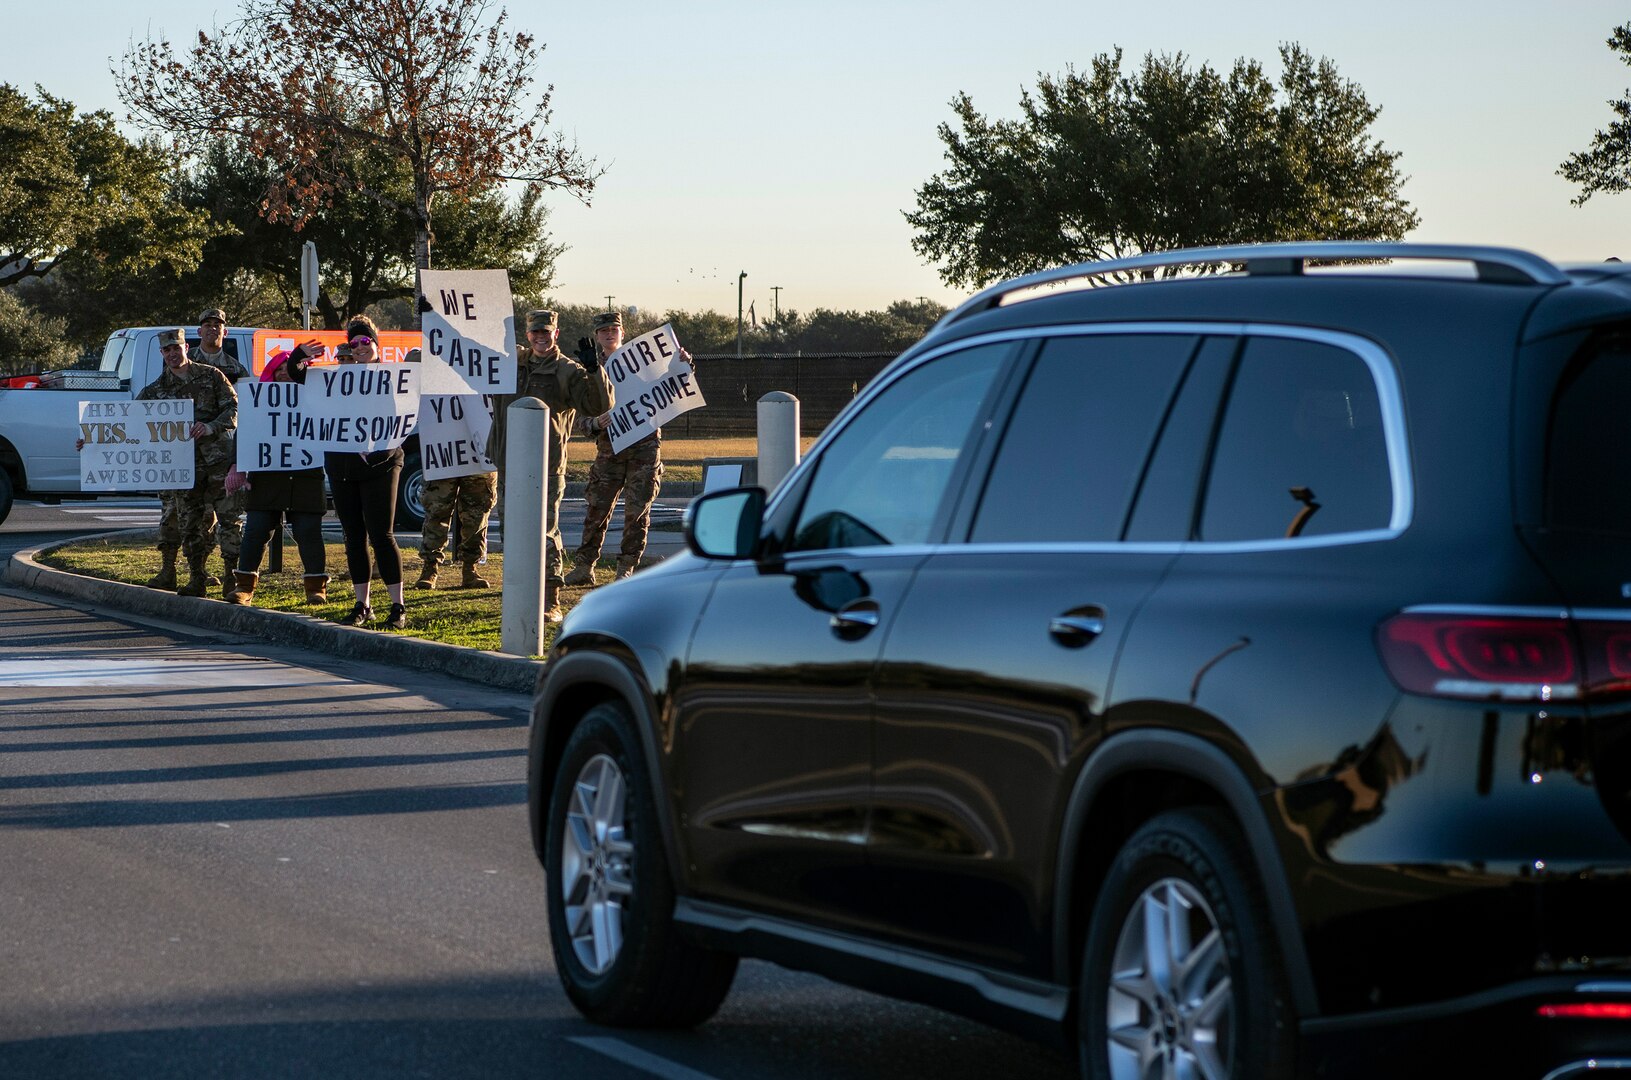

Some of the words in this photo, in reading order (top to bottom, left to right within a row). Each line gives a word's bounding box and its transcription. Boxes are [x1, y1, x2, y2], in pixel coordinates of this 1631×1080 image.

[440, 289, 477, 320] WE
[429, 328, 500, 385] CARE
[249, 383, 299, 408] YOU
[608, 372, 697, 442] AWESOME
[87, 403, 131, 418] HEY
[142, 401, 186, 416] YOU
[146, 421, 194, 442] YOU
[300, 414, 415, 443] AWESOME
[102, 449, 172, 465] YOU'RE
[84, 469, 191, 484] AWESOME
